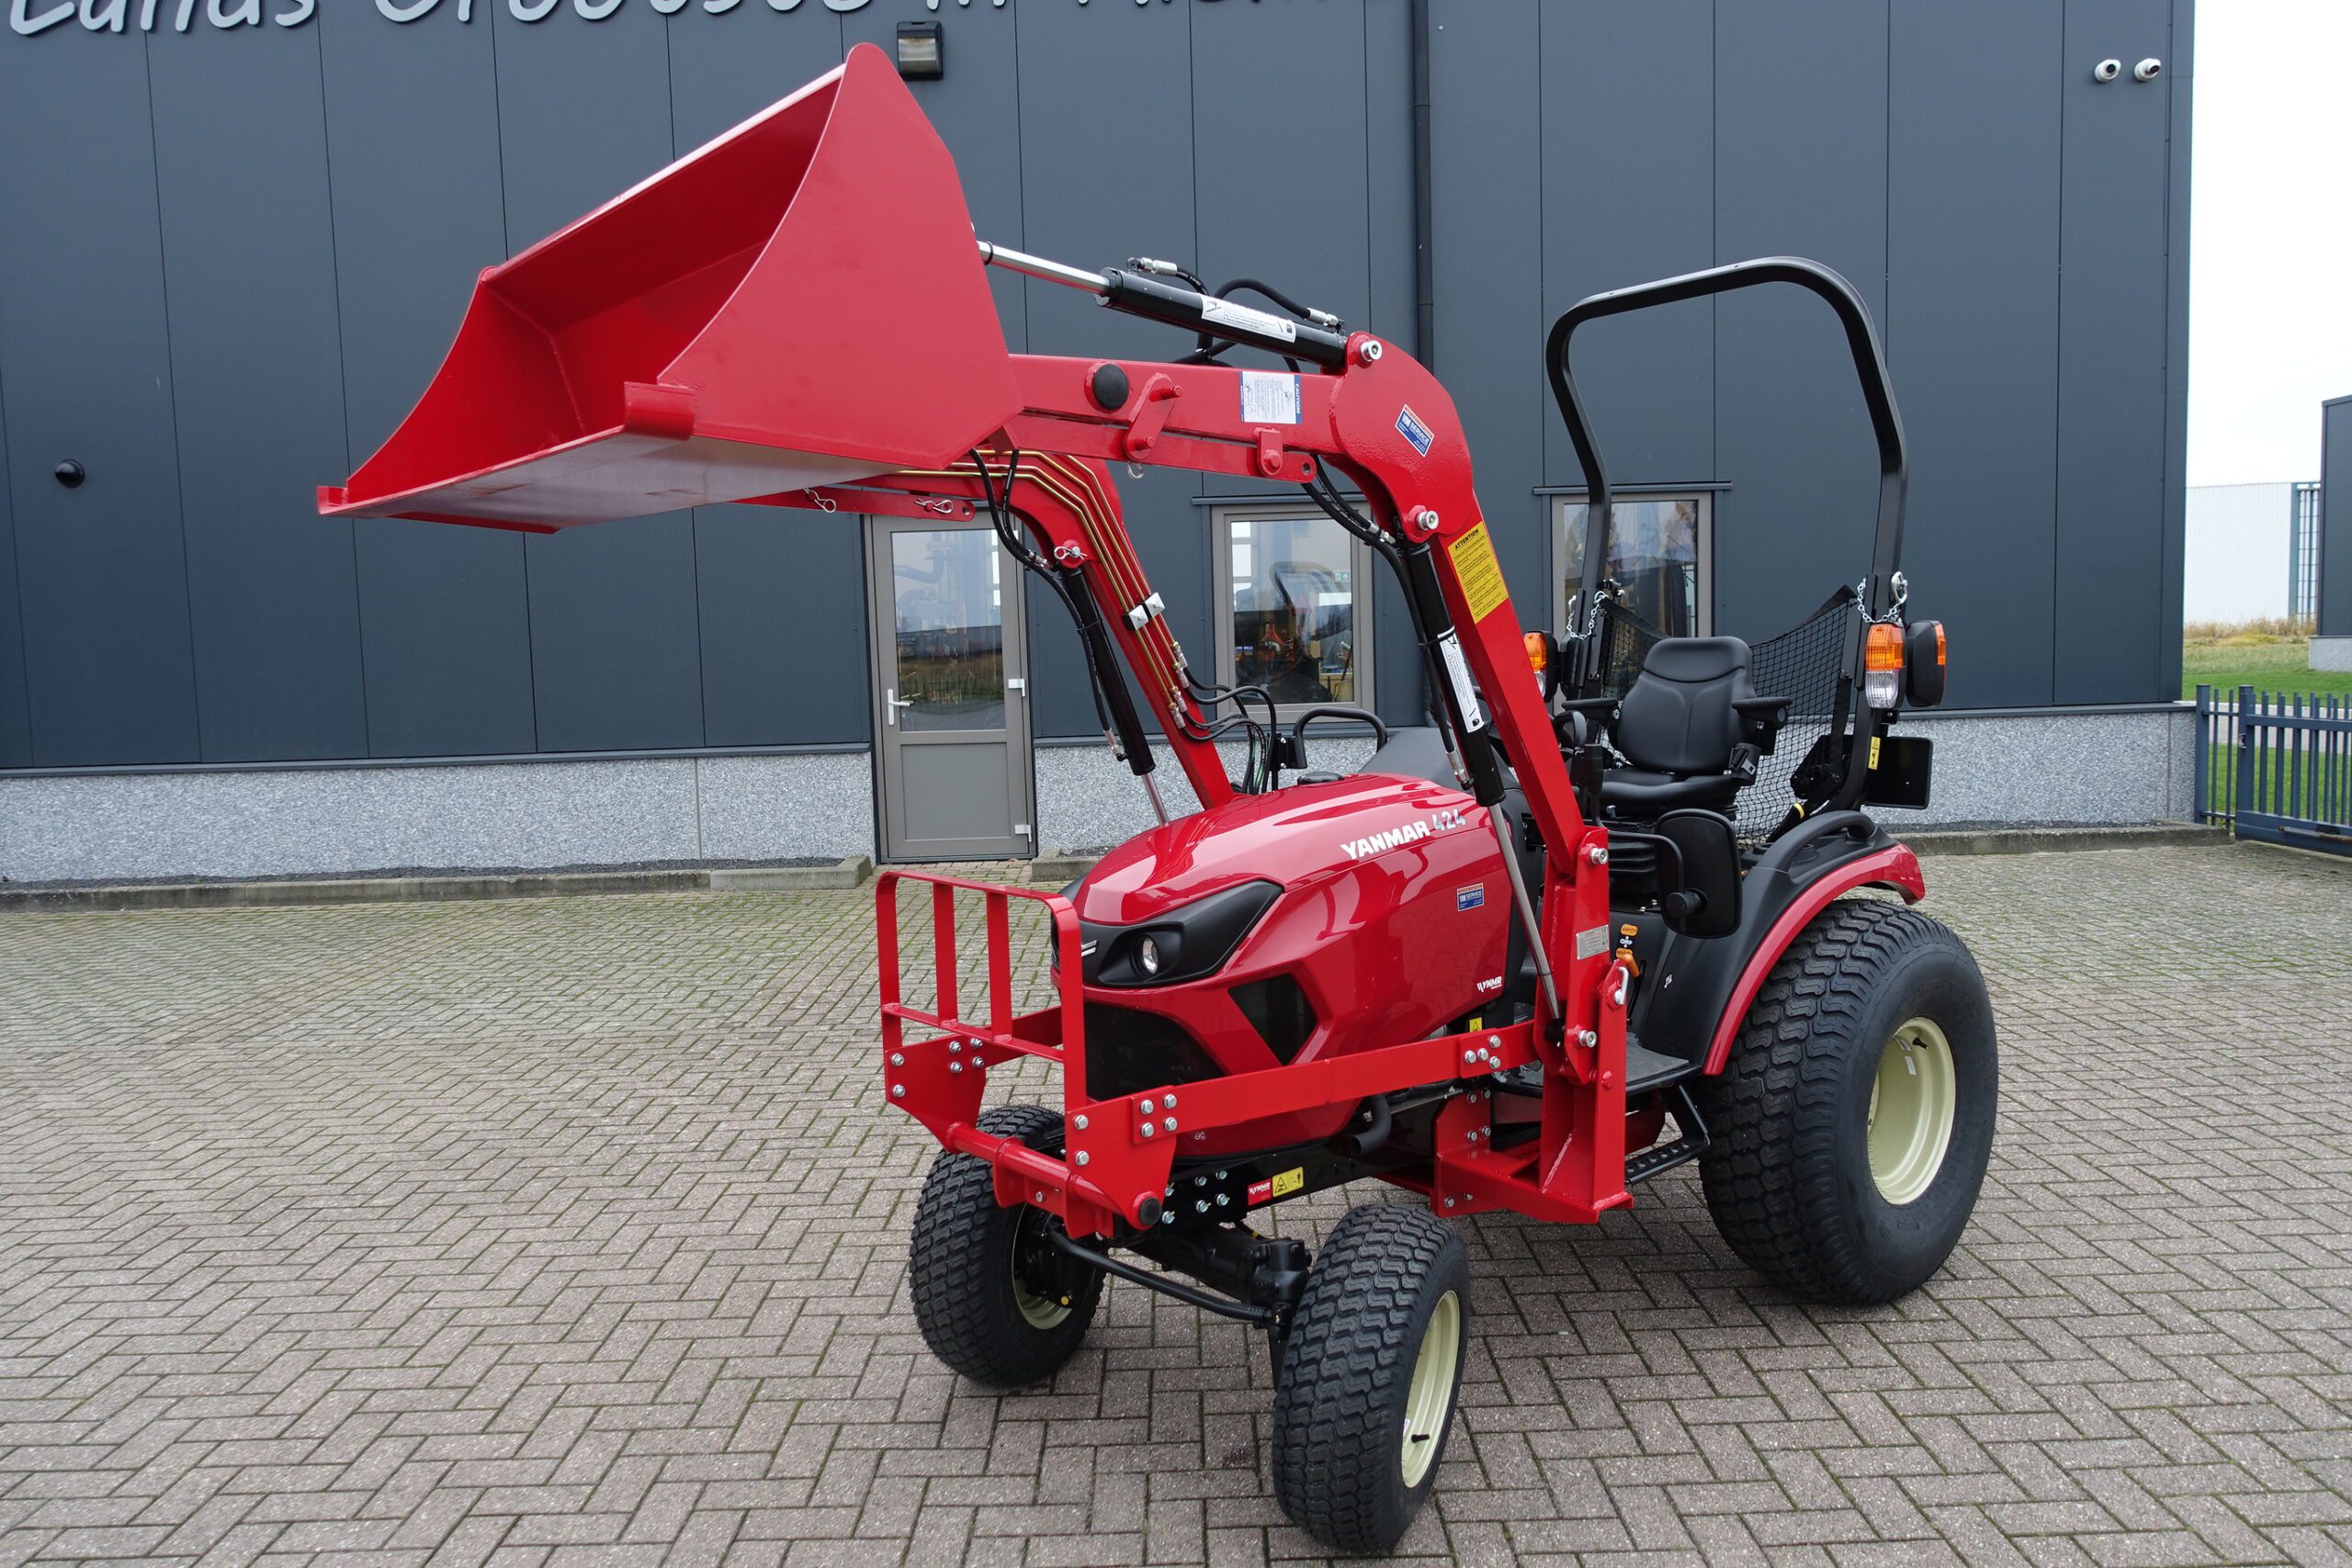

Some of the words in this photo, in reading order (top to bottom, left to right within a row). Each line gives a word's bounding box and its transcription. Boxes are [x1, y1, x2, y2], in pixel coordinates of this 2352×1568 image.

[1454, 528, 1479, 550] ATTENTION
[1340, 820, 1430, 860] YANMAR
[1431, 808, 1466, 830] 424
